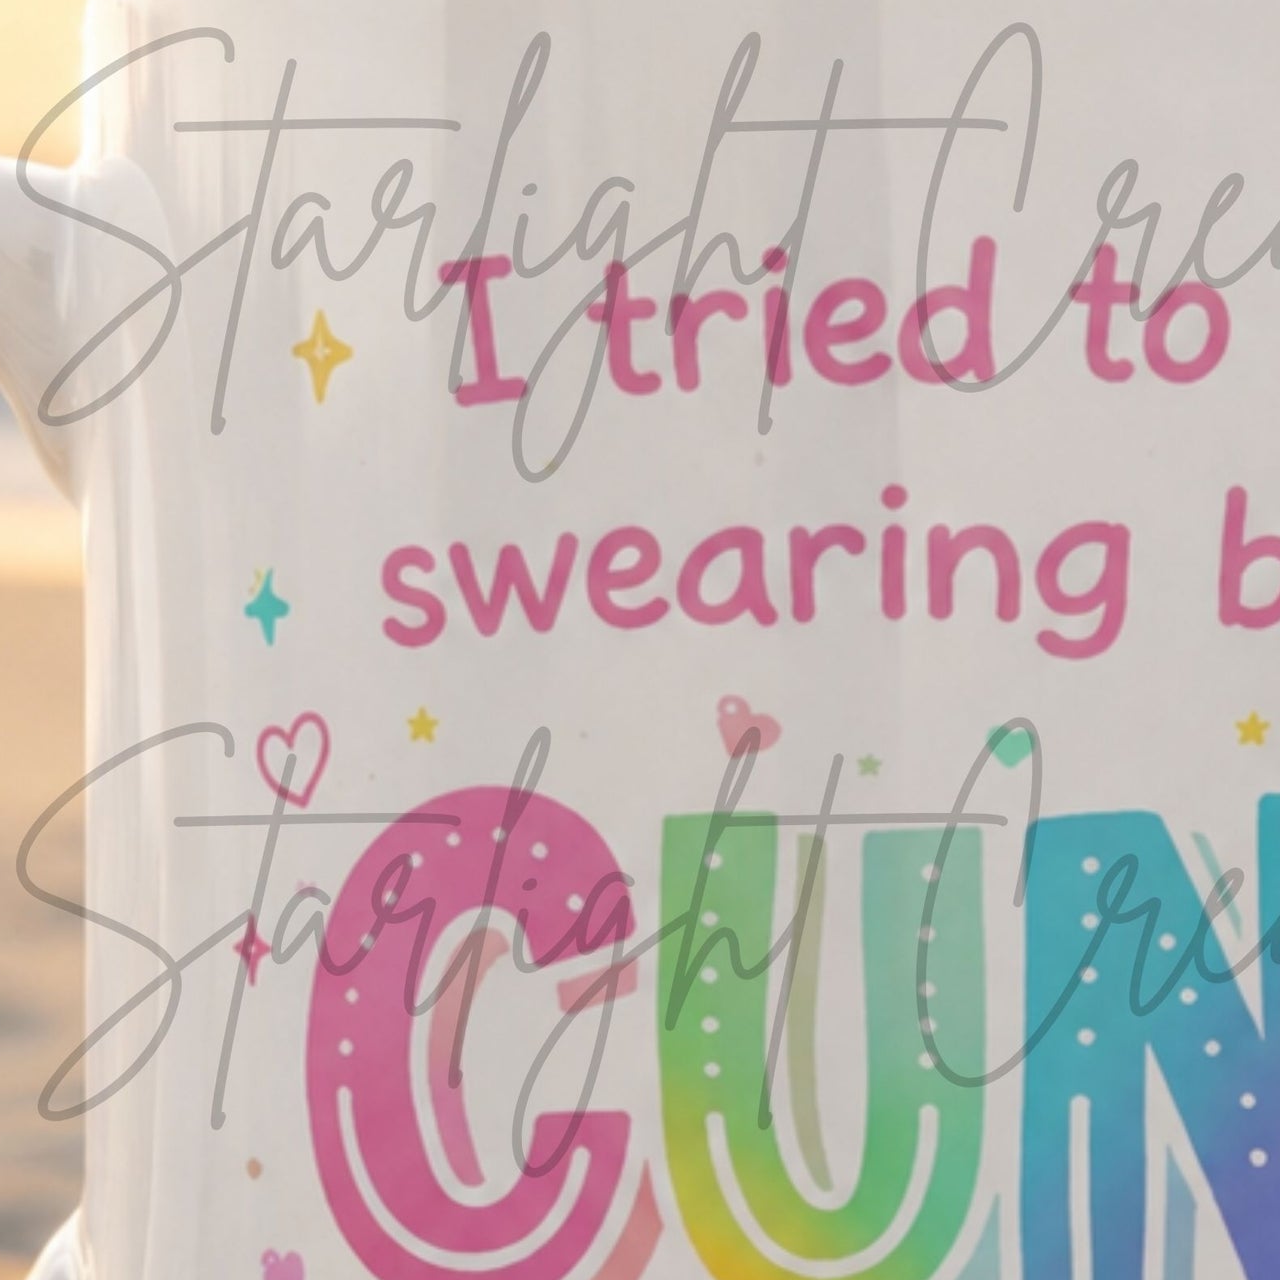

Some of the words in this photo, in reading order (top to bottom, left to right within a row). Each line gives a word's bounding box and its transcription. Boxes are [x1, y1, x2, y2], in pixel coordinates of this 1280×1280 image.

[438, 253, 528, 407] I
[586, 234, 997, 396] tried
[1068, 243, 1232, 385] to
[380, 483, 1132, 662] swearing
